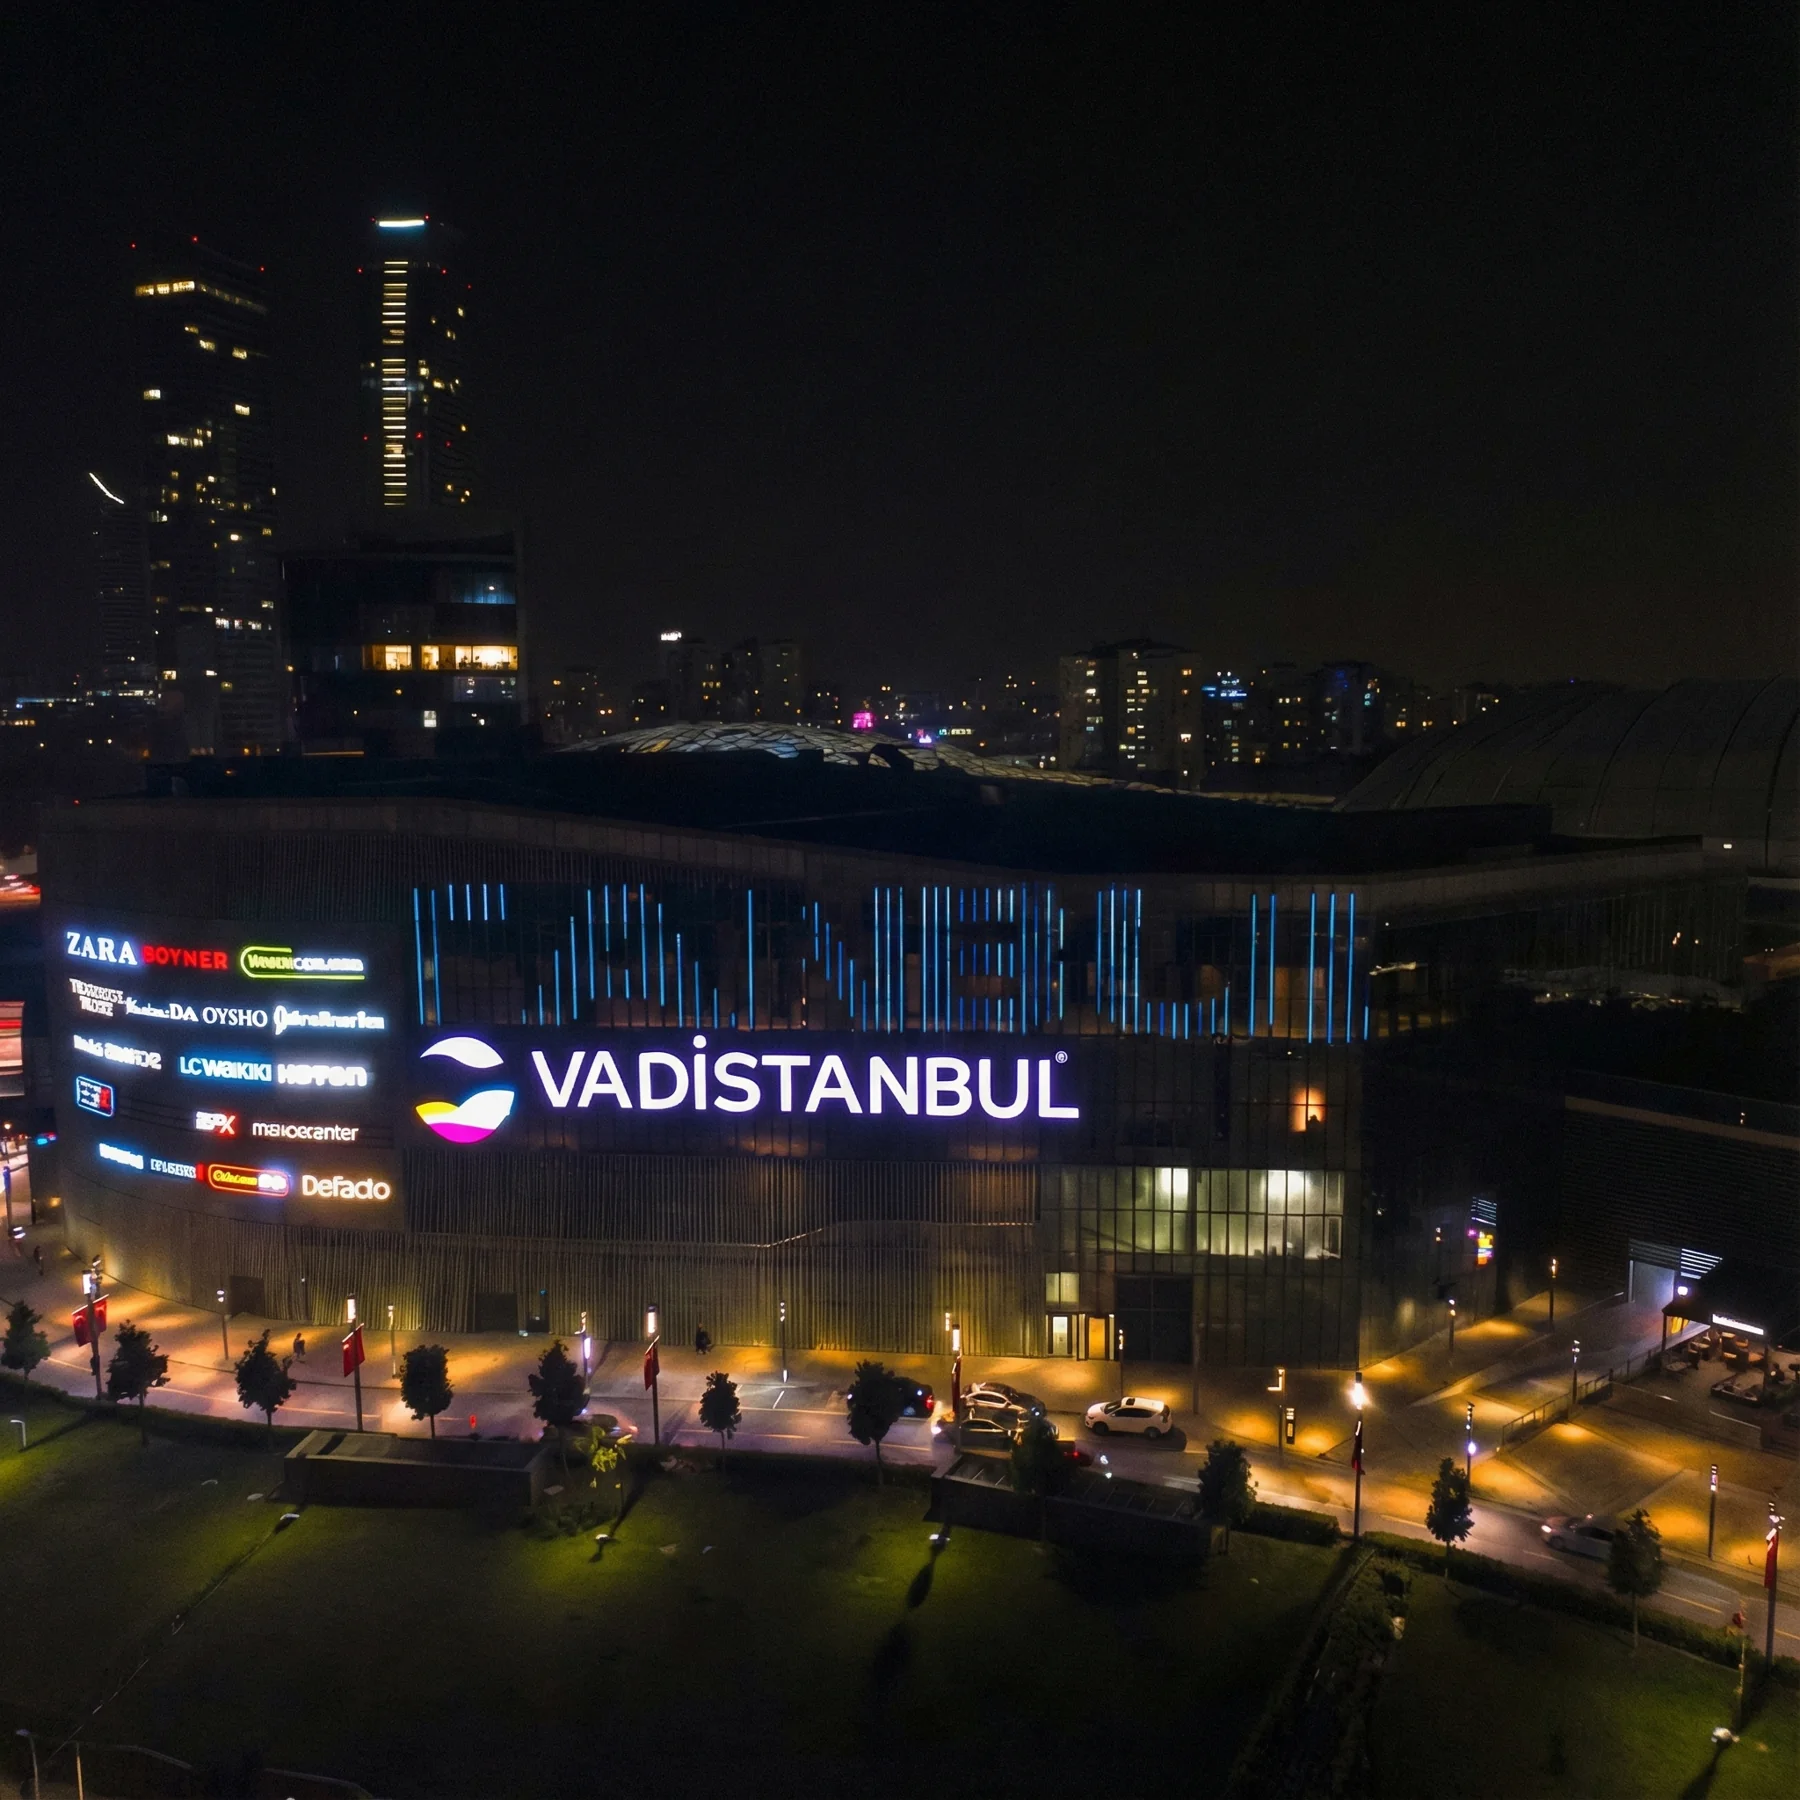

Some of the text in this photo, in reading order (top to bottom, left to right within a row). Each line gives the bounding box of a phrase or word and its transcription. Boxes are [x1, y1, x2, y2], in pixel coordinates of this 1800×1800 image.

[67, 932, 137, 965] ZARA
[142, 945, 227, 969] BOYNER
[202, 1007, 268, 1028] OYSHO
[532, 1035, 1078, 1118] VADİSTANBUL
